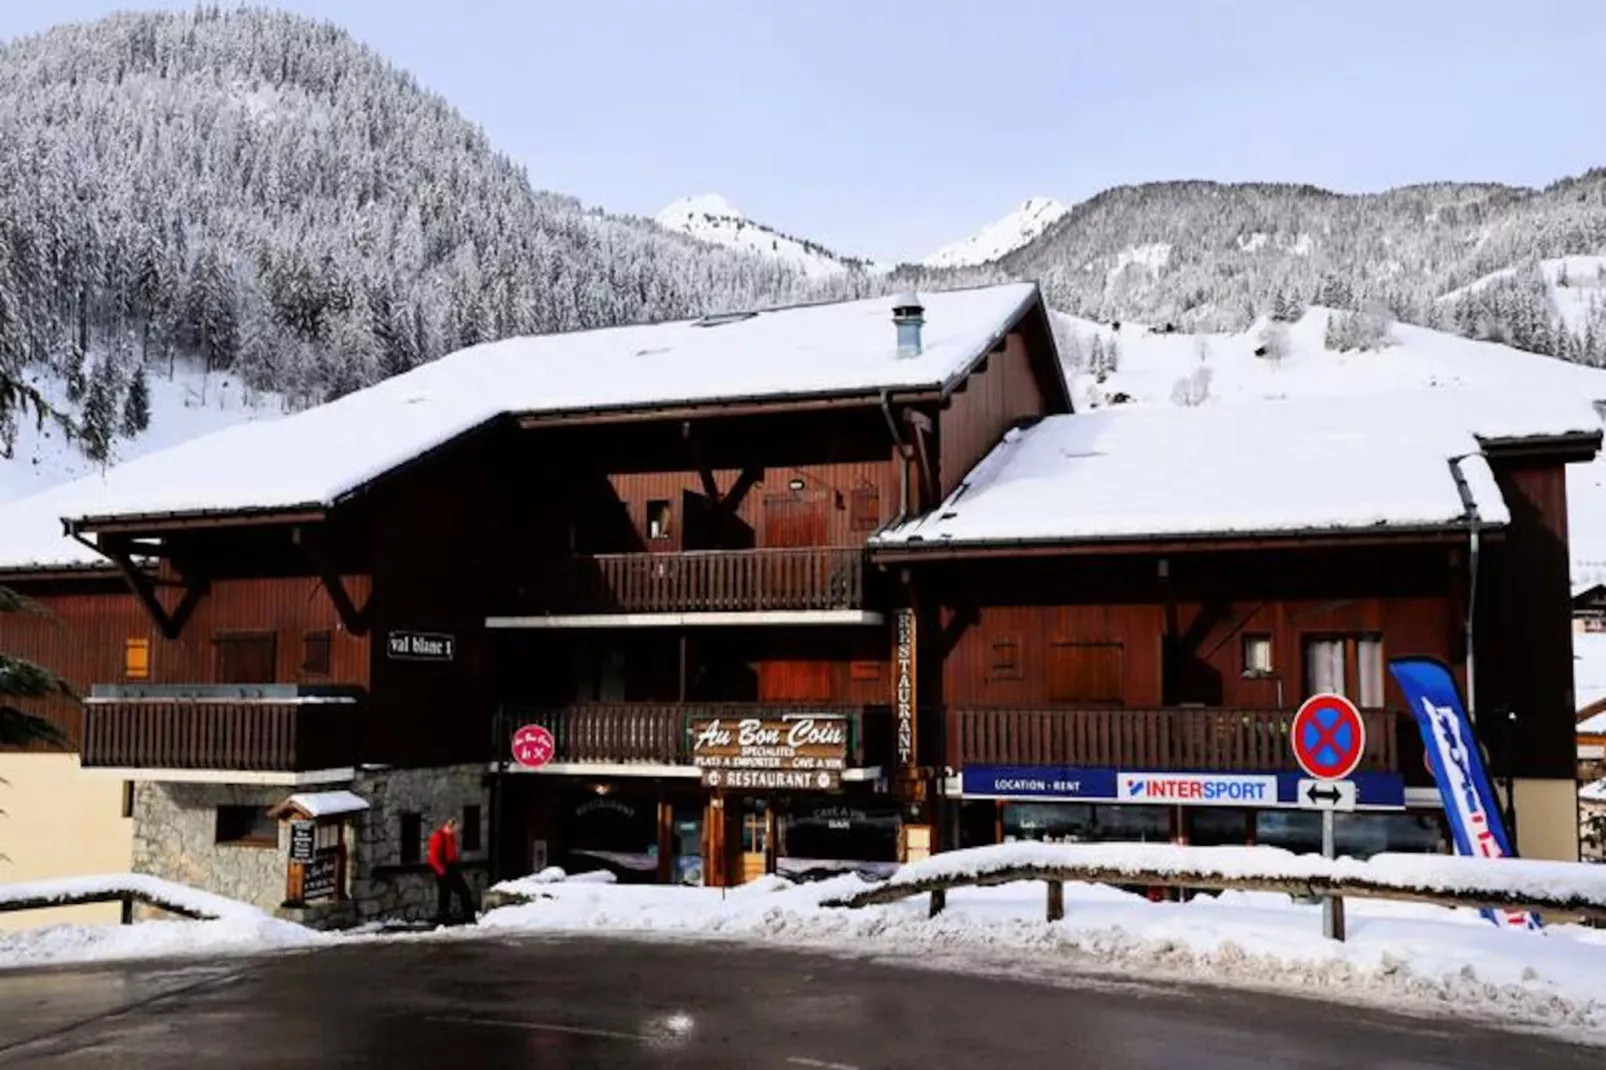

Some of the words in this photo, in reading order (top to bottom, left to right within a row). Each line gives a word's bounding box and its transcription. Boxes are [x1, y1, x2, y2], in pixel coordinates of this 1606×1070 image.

[391, 636, 409, 653] val
[898, 614, 911, 763] RESTAURANT
[694, 719, 731, 750] Au
[738, 719, 780, 746] Bon
[787, 719, 842, 748] Coin
[726, 770, 812, 788] RESTAURANT
[994, 779, 1045, 791] LOCATION
[1053, 780, 1081, 791] RENT
[1146, 780, 1266, 799] INTERSPORT
